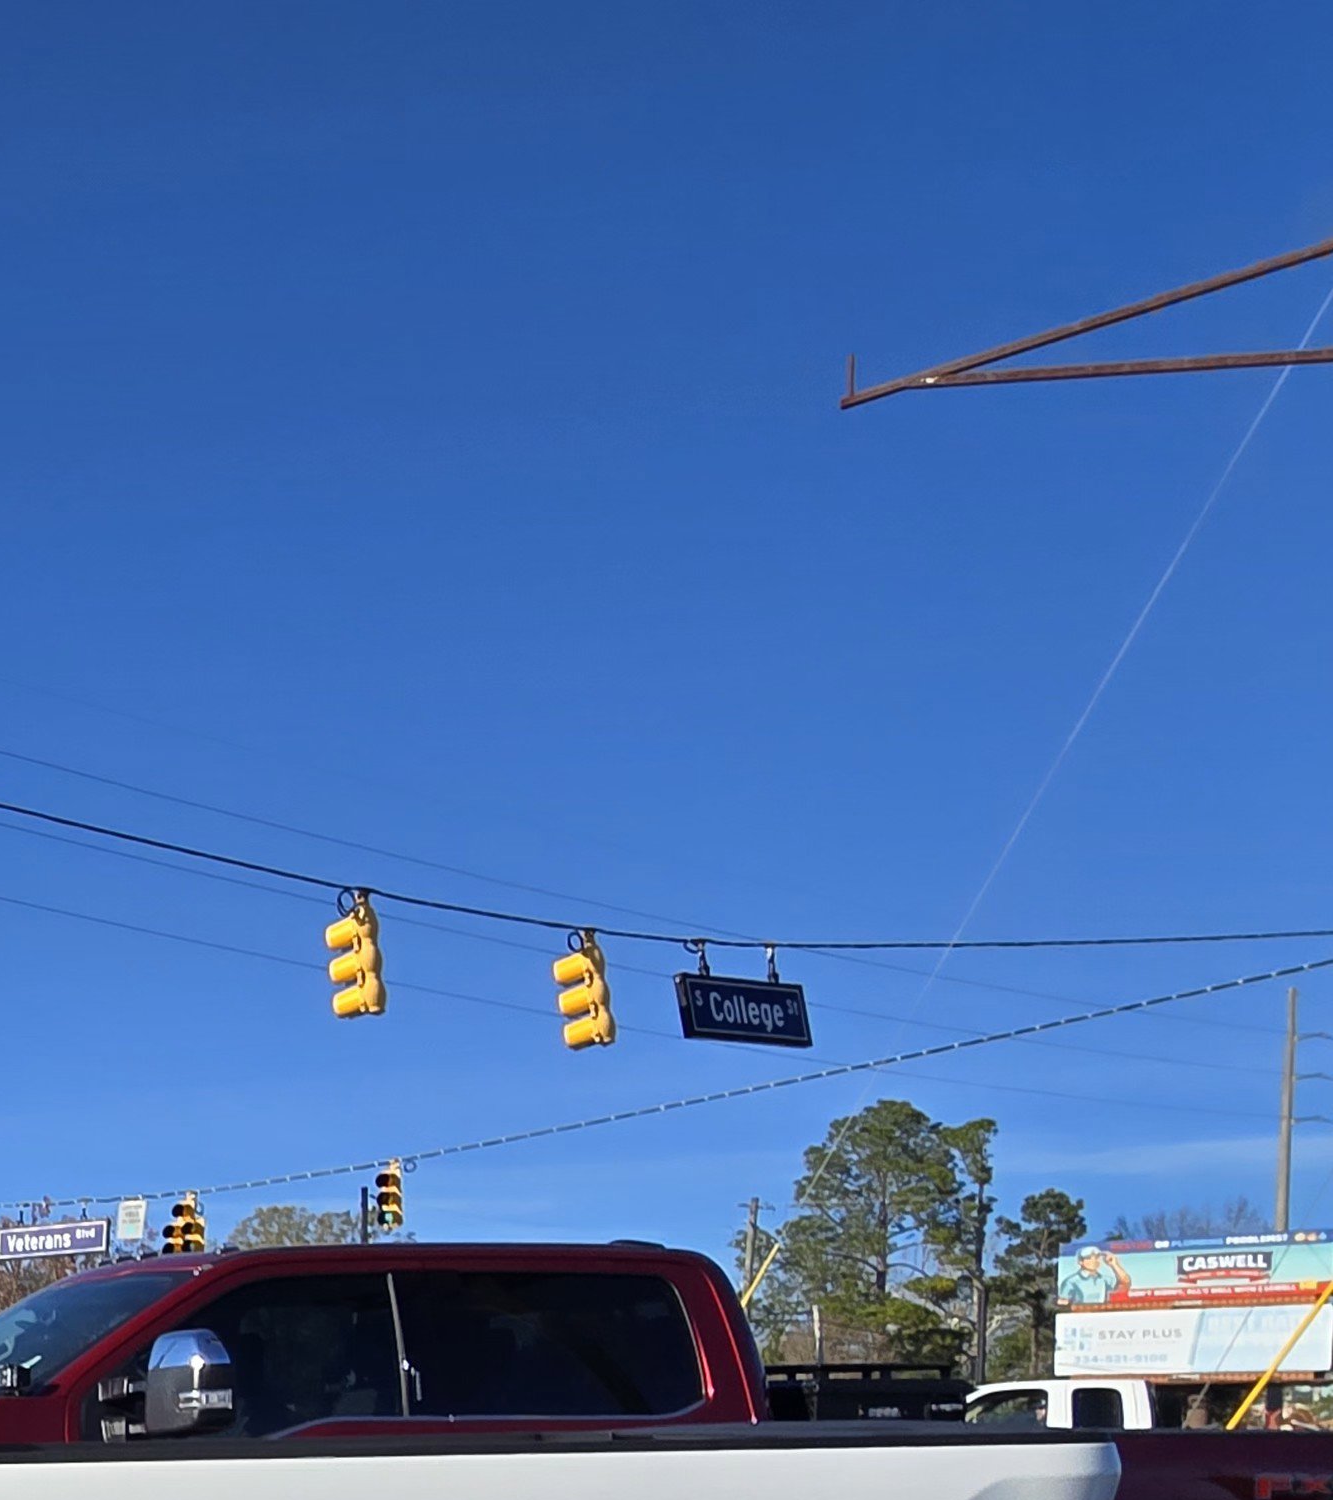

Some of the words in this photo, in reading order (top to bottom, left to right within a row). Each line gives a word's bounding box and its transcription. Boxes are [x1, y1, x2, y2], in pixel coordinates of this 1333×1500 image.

[694, 989, 703, 1006] S
[709, 991, 785, 1033] College
[786, 998, 799, 1016] St
[7, 1233, 72, 1252] Veterans
[75, 1227, 96, 1240] Blvd
[1182, 1253, 1268, 1272] CASWELL
[1098, 1329, 1135, 1340] STAY
[1142, 1327, 1182, 1339] PLUS
[1254, 1472, 1333, 1500] FX
